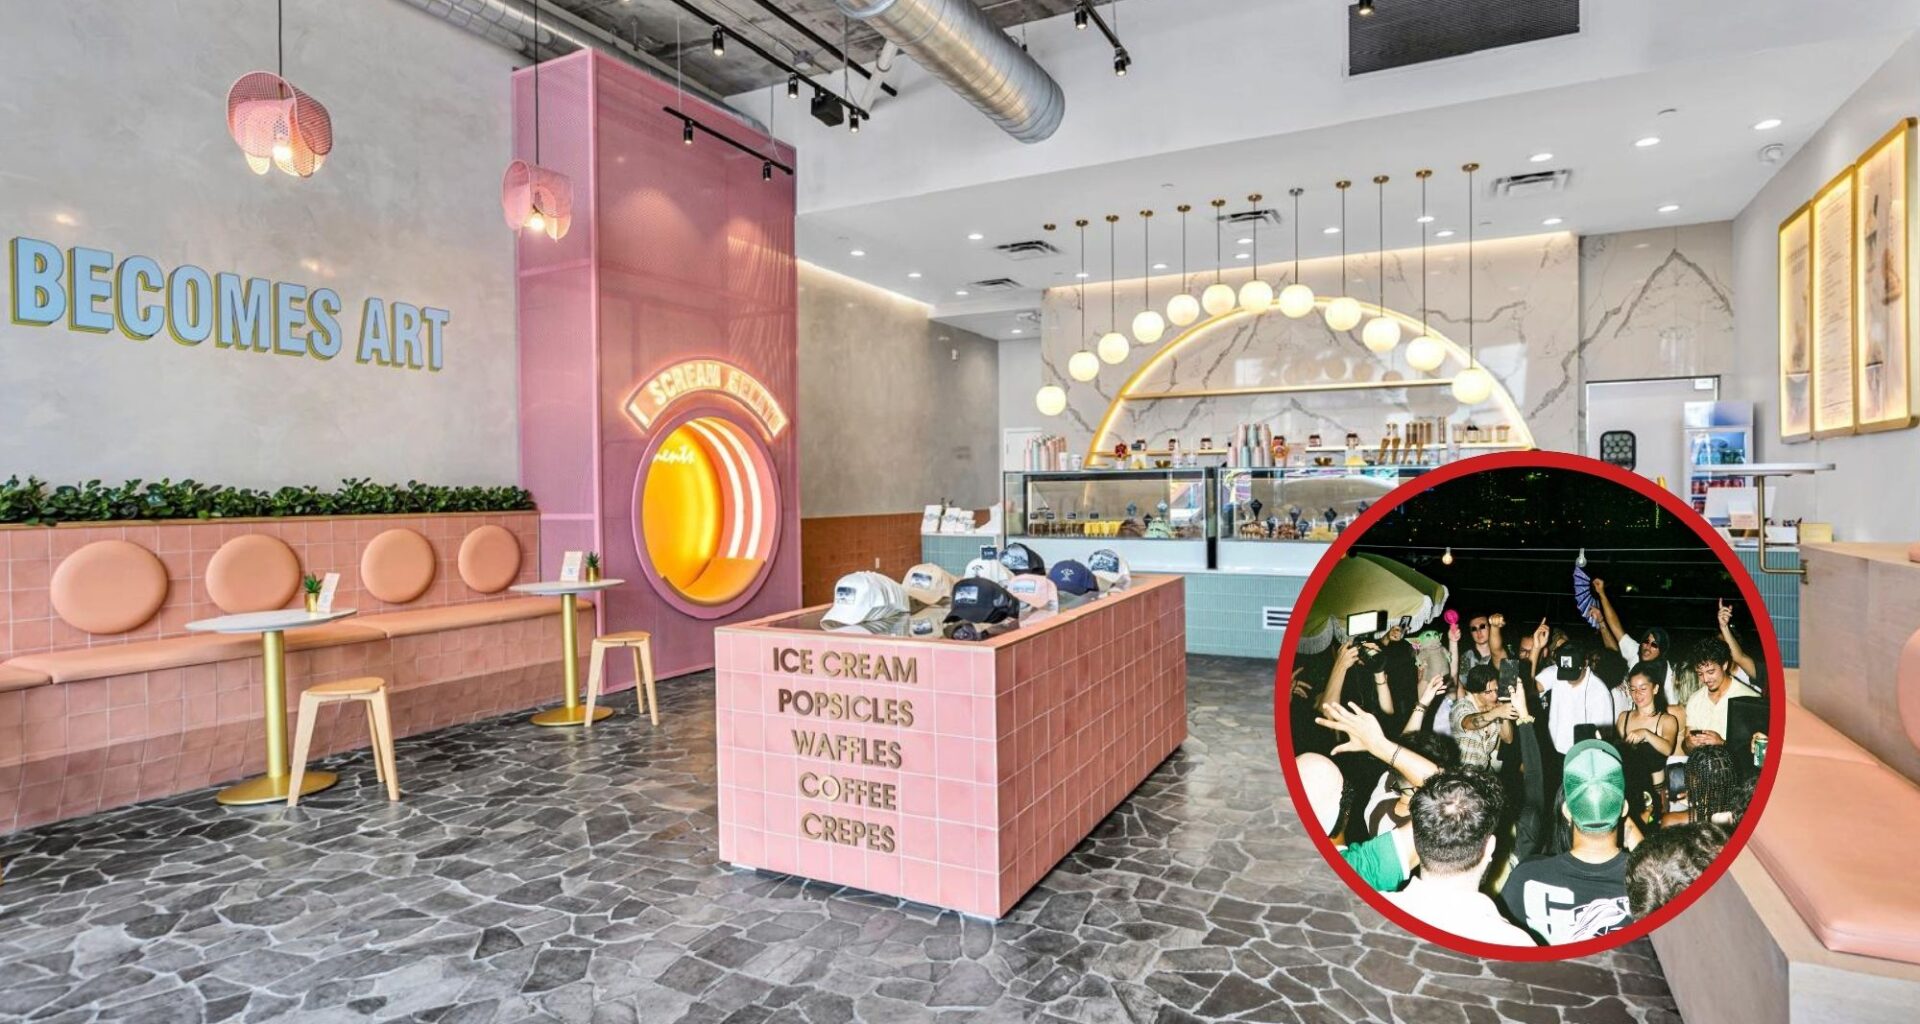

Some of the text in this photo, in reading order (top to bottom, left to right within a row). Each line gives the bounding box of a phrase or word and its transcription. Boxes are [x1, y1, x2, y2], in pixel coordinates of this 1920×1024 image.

[9, 236, 450, 372] BECOMES ART
[648, 363, 722, 406] SCREAM
[773, 647, 918, 684] ICE CREAM
[778, 689, 915, 727] POPSICLES
[791, 730, 902, 769] WAFFLES
[800, 772, 897, 811] COFFEE
[802, 813, 896, 853] CREPES
